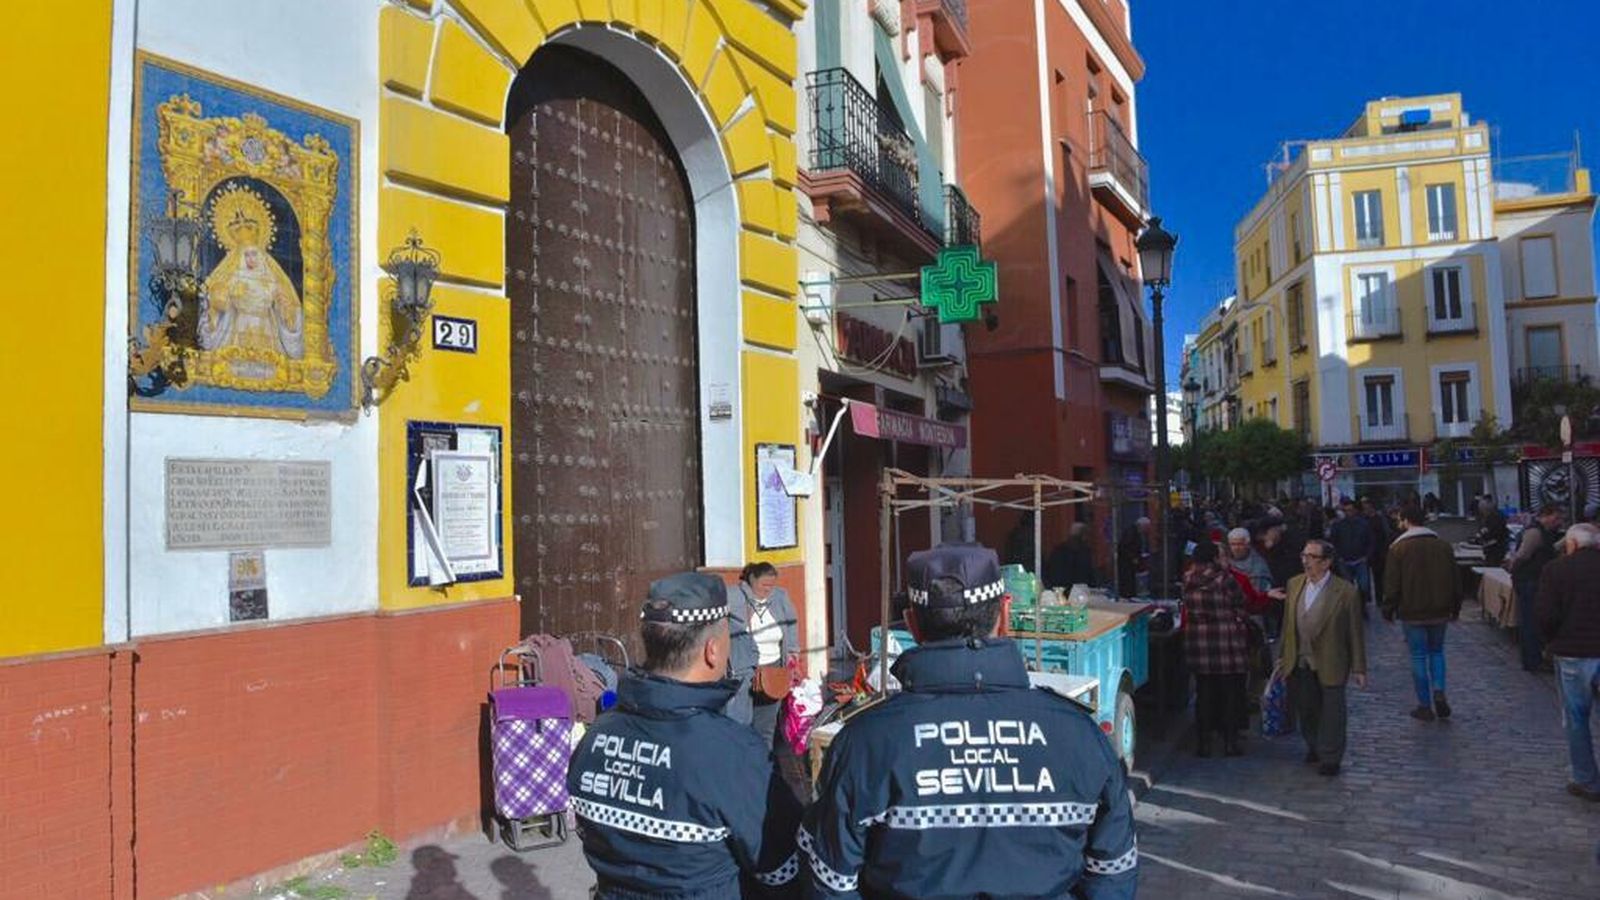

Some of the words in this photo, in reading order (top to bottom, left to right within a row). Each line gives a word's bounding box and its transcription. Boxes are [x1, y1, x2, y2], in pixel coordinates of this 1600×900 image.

[440, 322, 470, 346] 29
[914, 720, 1047, 747] POLICIA
[591, 733, 671, 769] POLICIA
[951, 748, 1019, 764] LOCAL
[604, 759, 646, 780] LOCAL
[916, 767, 1056, 796] SEVILLA
[580, 771, 664, 810] SEVILLA
